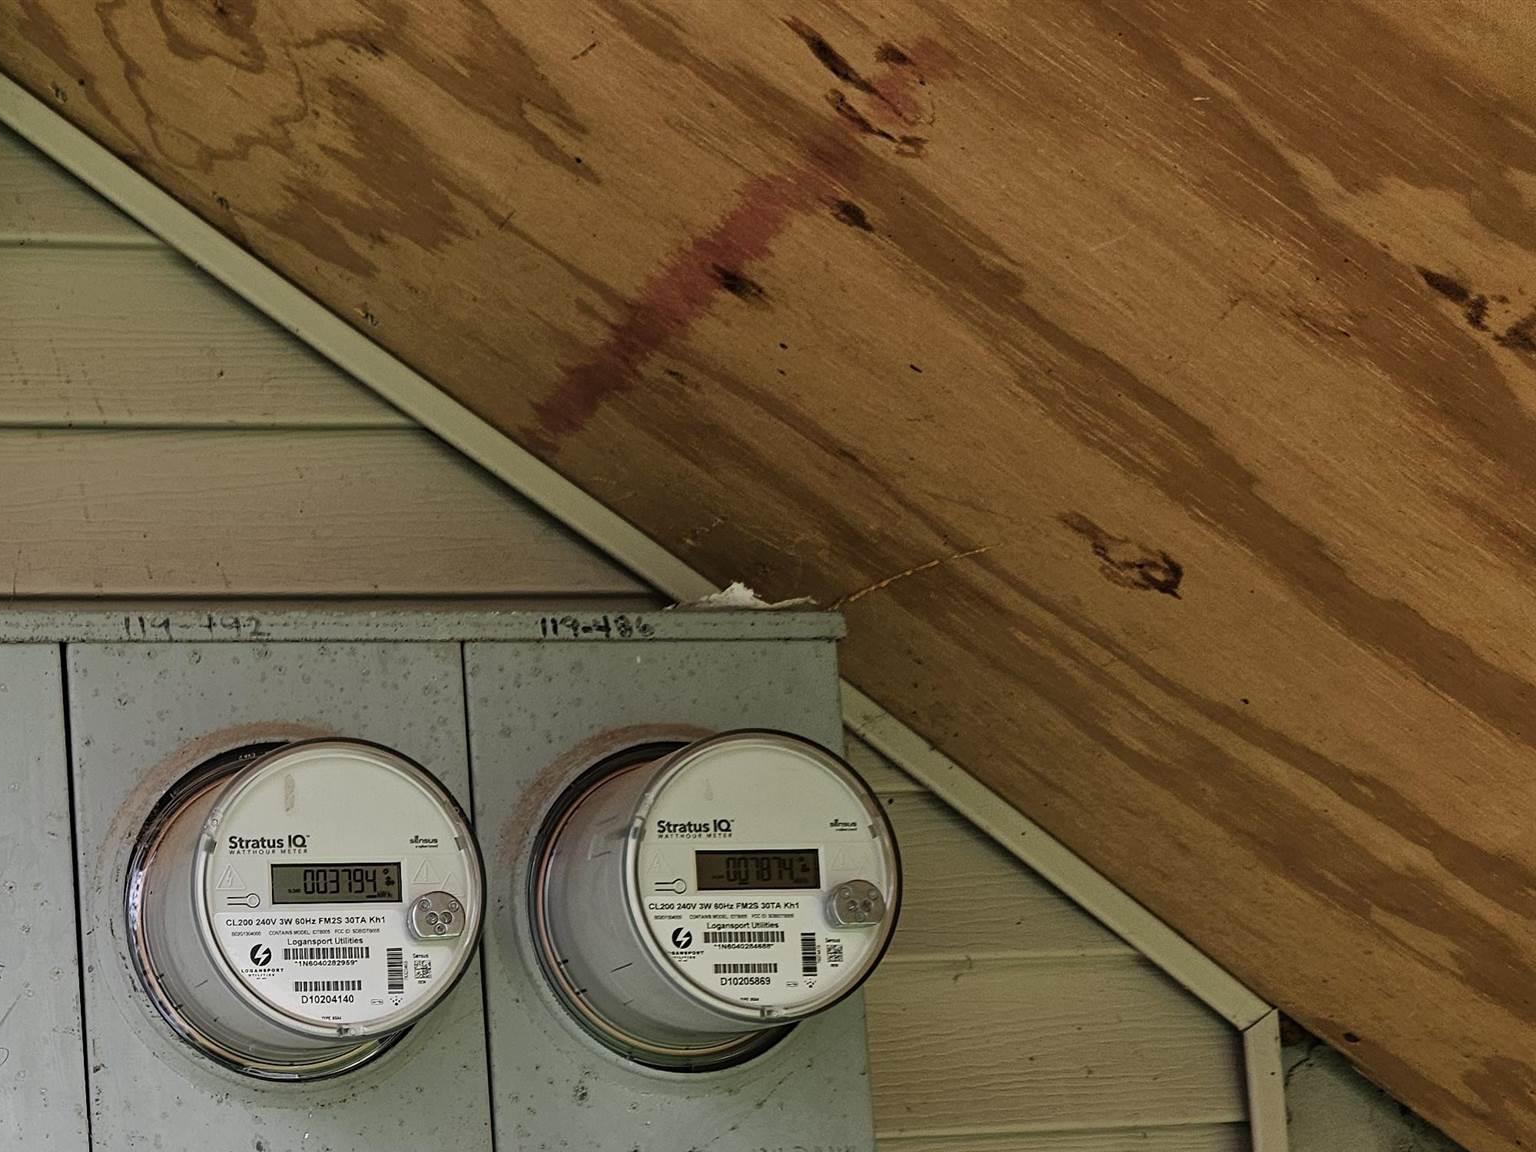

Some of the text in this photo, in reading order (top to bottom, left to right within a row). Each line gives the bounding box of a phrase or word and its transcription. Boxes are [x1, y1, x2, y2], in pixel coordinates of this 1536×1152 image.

[657, 820, 710, 833] Stratus
[229, 836, 284, 849] Stratus
[303, 868, 377, 895] 003794
[707, 922, 750, 930] Logansport
[287, 938, 333, 946] Logansport
[720, 977, 771, 986] D10205869
[302, 995, 354, 1004] D10204140
